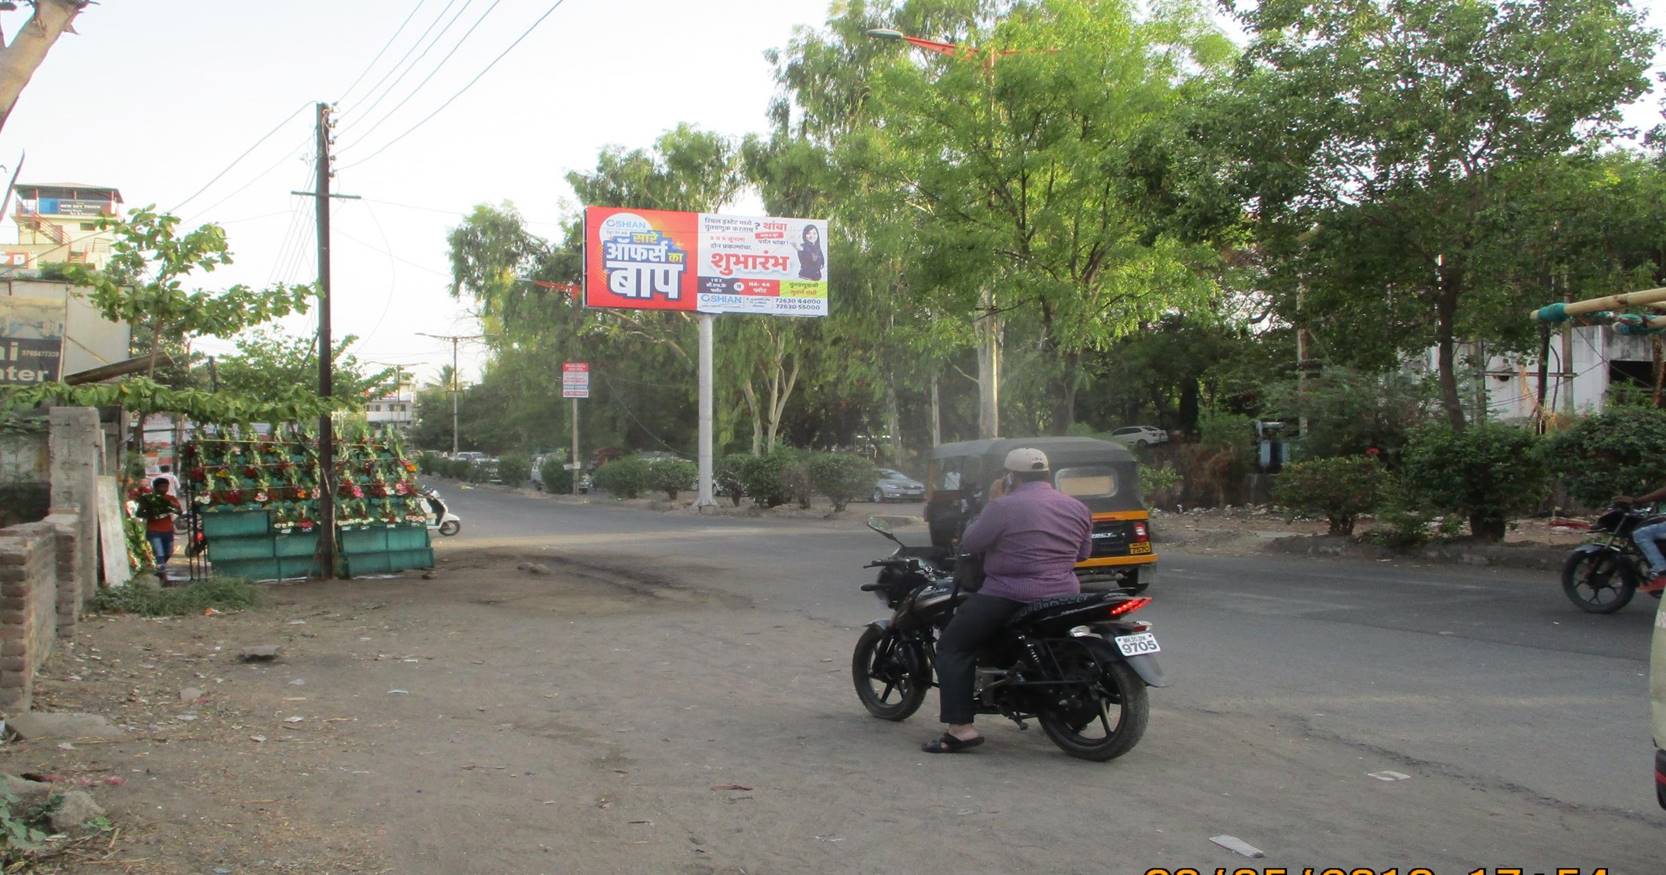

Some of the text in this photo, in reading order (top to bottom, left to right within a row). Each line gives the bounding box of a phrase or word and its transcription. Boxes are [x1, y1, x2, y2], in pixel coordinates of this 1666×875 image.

[606, 238, 683, 263] ऑफर्स का
[711, 250, 789, 275] शुभारंभ
[606, 260, 684, 299] बाप
[701, 294, 742, 304] OSHIAN
[1122, 640, 1157, 653] 9705
